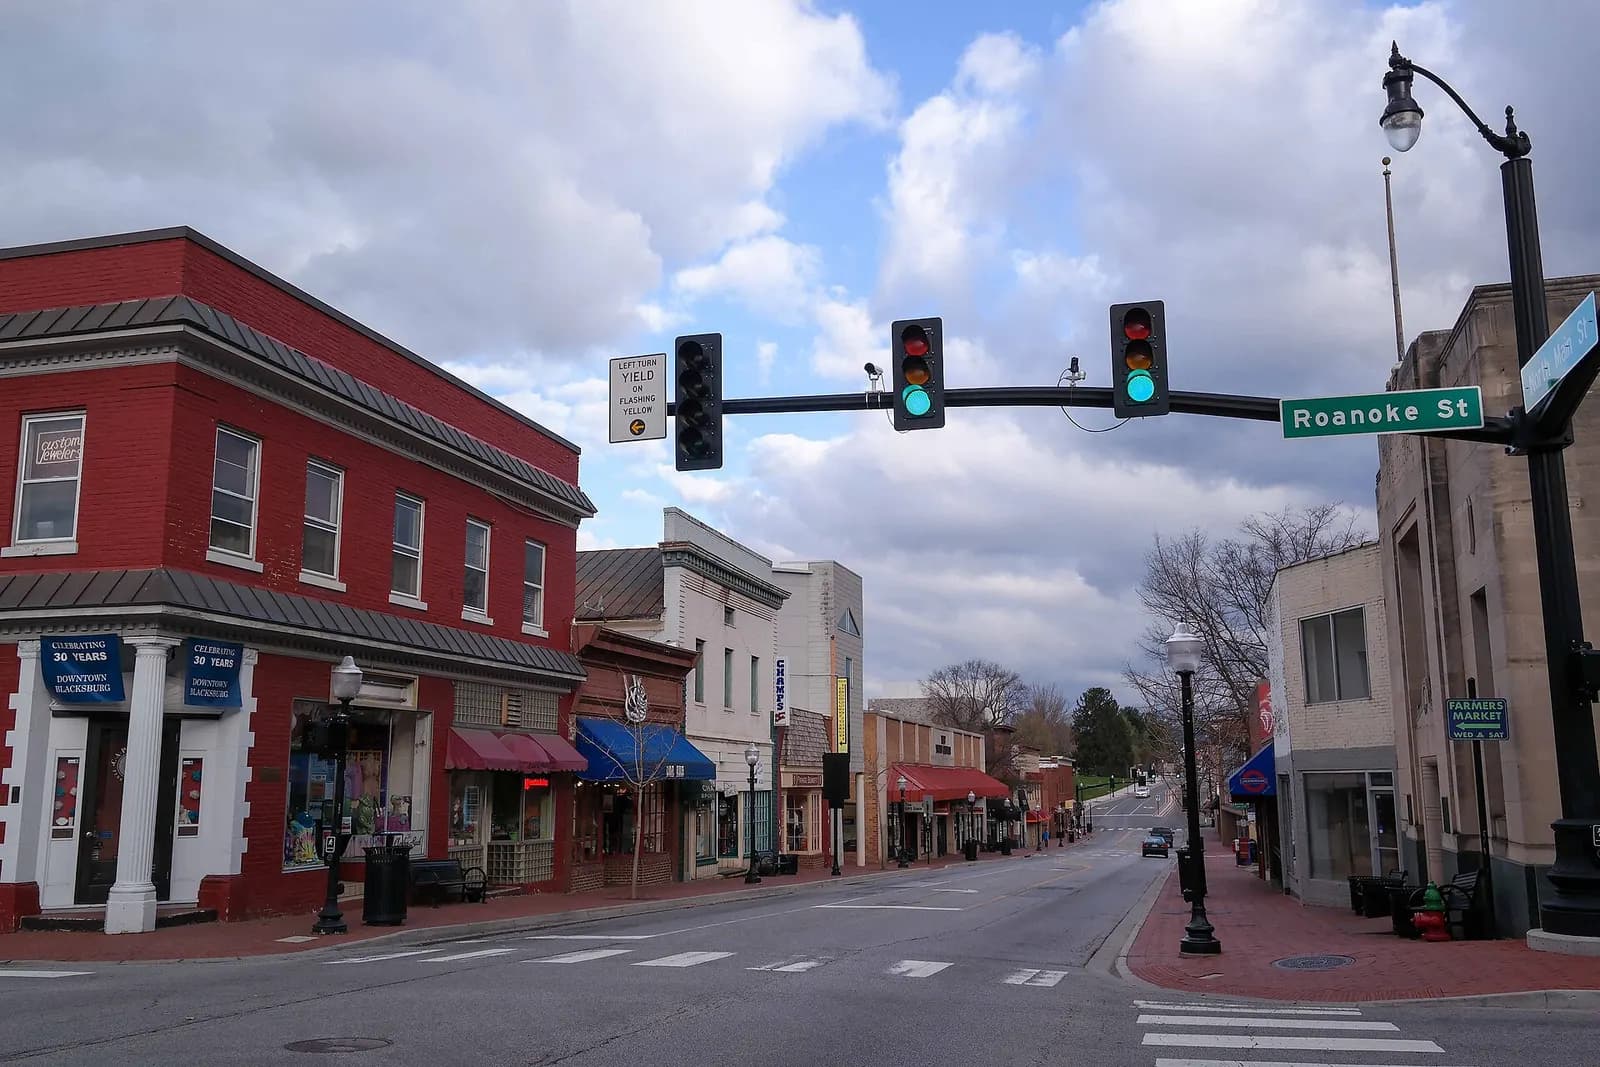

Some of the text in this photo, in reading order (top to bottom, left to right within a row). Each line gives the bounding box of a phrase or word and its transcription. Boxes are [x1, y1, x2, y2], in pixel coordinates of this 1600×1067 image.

[1553, 336, 1573, 368] Main
[1577, 319, 1588, 344] St
[618, 359, 657, 370] LEFT TURN
[622, 370, 654, 383] YIELD
[632, 385, 643, 393] ON
[619, 394, 656, 405] FLASHING
[623, 406, 652, 416] YELLOW
[1293, 398, 1469, 429] Roanoke St
[41, 436, 81, 451] custom
[52, 641, 106, 650] CELEBRATING
[194, 644, 236, 656] CELEBRATING
[53, 651, 108, 662] 30 YEARS
[193, 655, 234, 668] 30 YEARS
[56, 674, 107, 683] DOWNTOWN
[192, 678, 229, 688] DOWNTOWN
[55, 684, 111, 693] BLACKSBURG
[776, 659, 785, 711] CHAMPS
[190, 687, 229, 698] BLACKSBURG
[1449, 701, 1504, 710] FARMERS
[1452, 711, 1502, 720] MARKET
